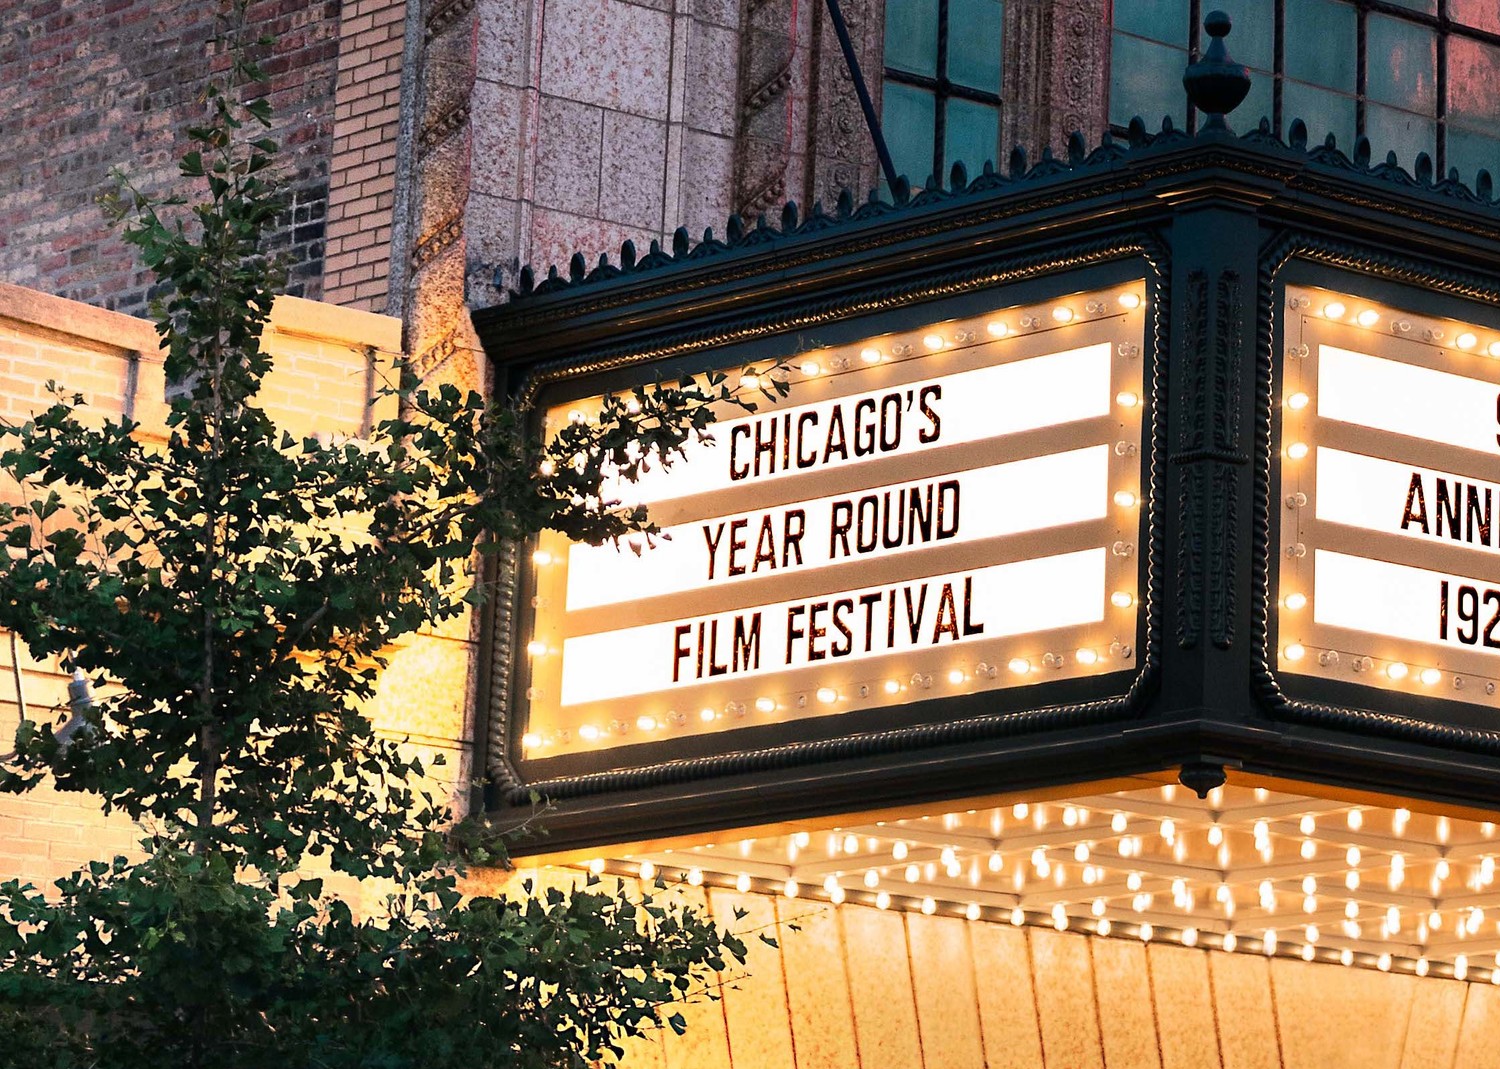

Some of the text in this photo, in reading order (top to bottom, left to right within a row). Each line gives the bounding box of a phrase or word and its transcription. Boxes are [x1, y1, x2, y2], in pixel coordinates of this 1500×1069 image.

[728, 382, 943, 482] CHICAGO'S
[701, 478, 961, 581] YEAR ROUND
[671, 575, 985, 684] FILM FESTIVAL
